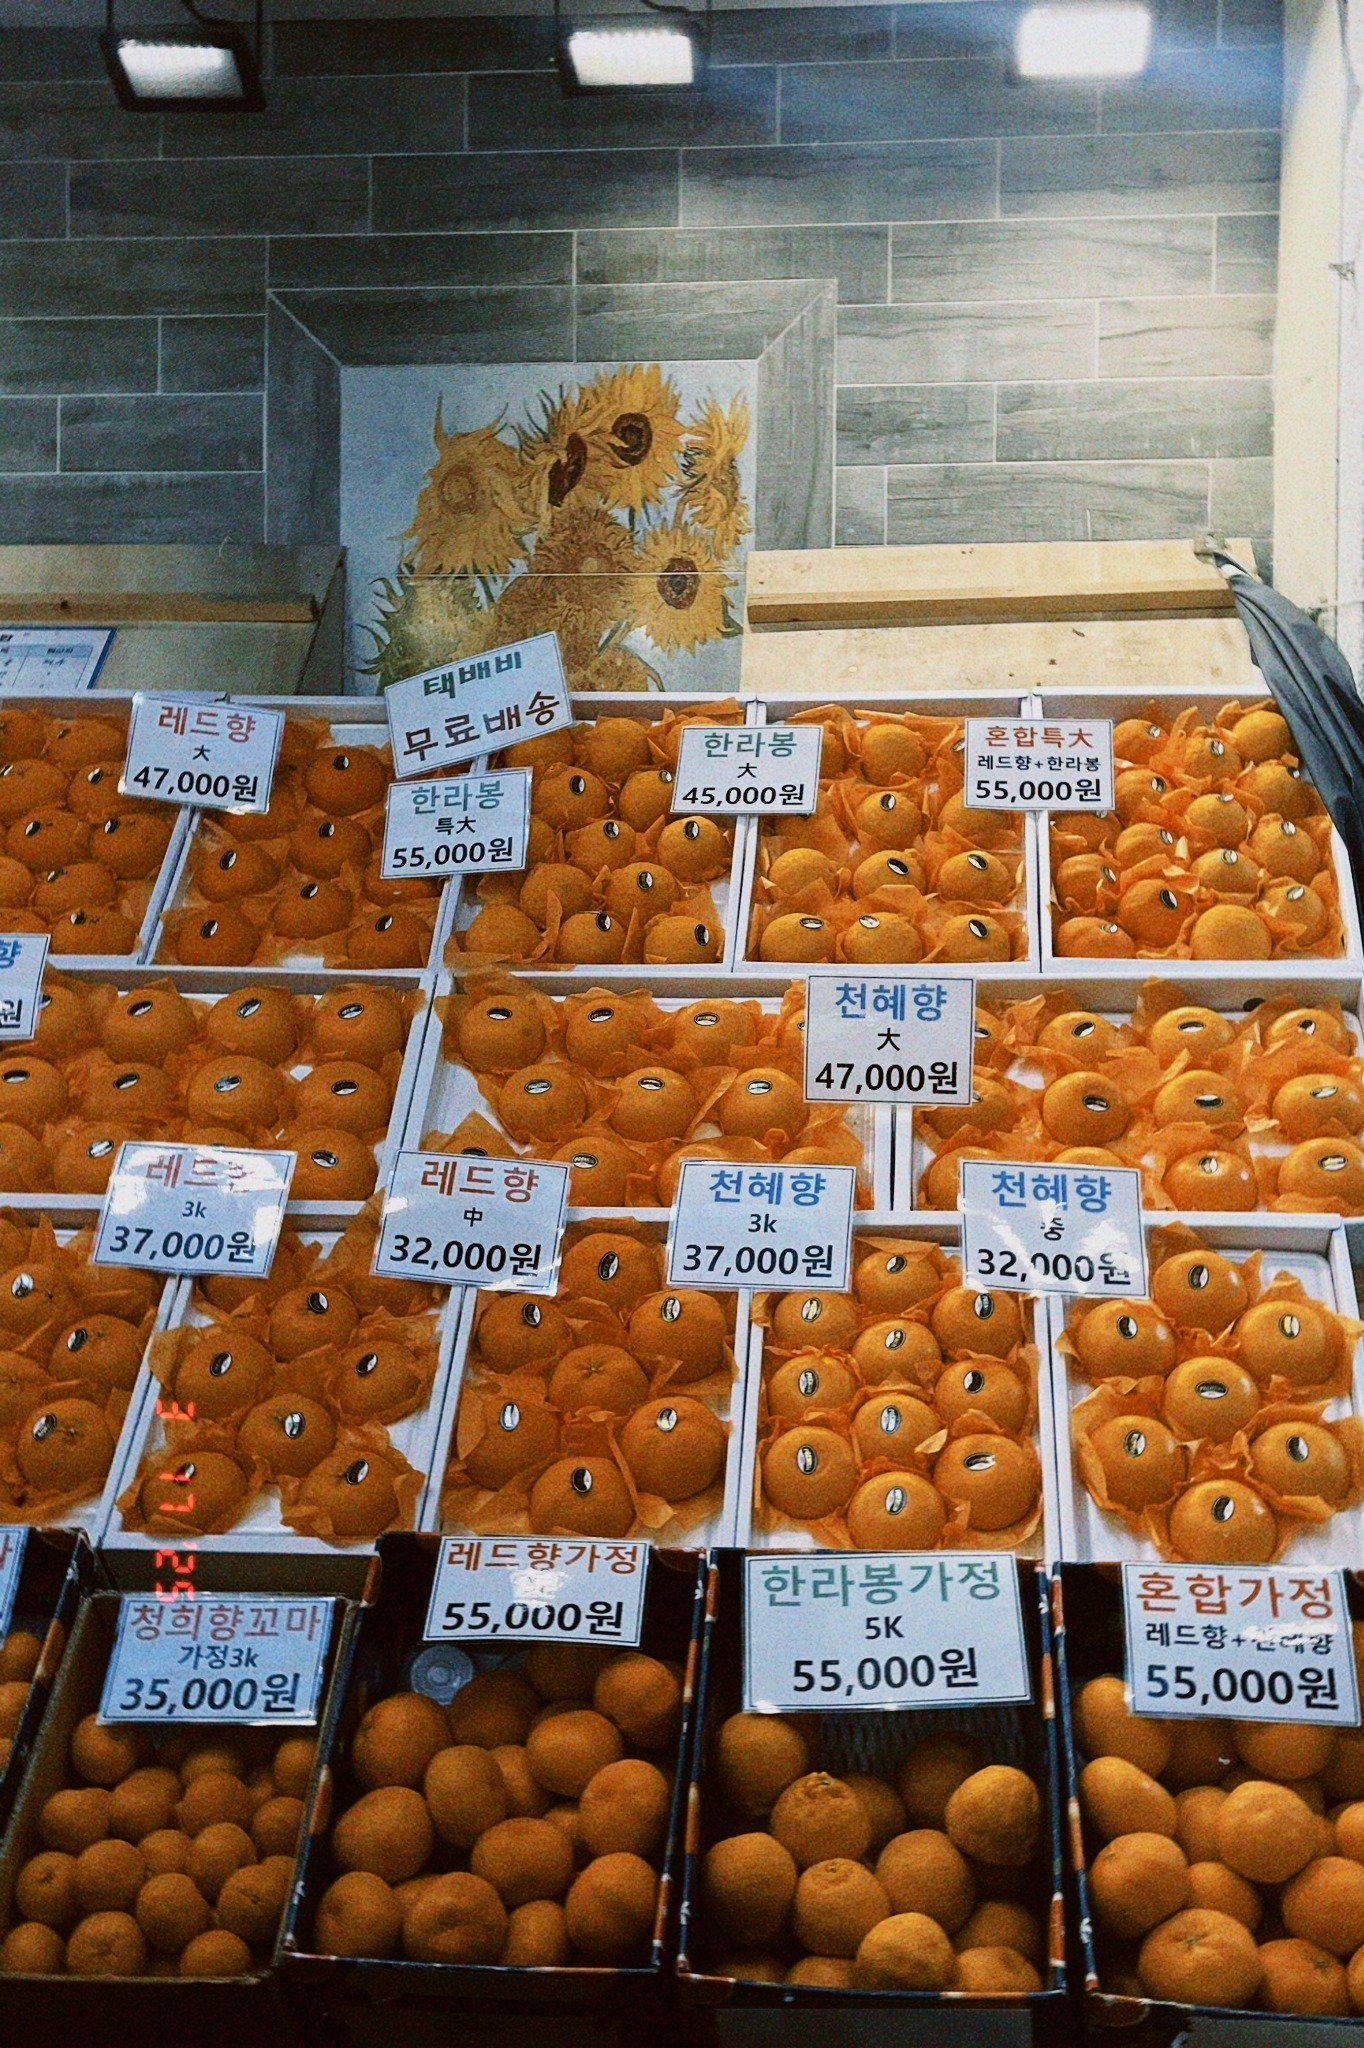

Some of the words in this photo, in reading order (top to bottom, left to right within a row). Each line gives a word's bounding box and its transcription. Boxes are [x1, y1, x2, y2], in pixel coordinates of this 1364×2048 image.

[423, 651, 523, 699] 택배비
[158, 705, 257, 743] 레드향
[403, 690, 561, 762] 무료배송
[985, 725, 1094, 748] 혼합특大
[192, 745, 210, 761] 大
[704, 731, 798, 758] 한라봉
[737, 762, 758, 778] 大
[977, 755, 1102, 772] 레드향+한라봉
[133, 766, 259, 803] 47,000원
[410, 779, 505, 815] 한라봉
[682, 783, 805, 807] 45,000원
[976, 778, 1102, 803] 55,000원
[391, 836, 514, 870] 55,000원
[835, 982, 948, 1022] 천혜향
[876, 1027, 901, 1052] 大
[815, 1061, 958, 1095] 47,000원
[420, 1160, 540, 1203] 레드향
[709, 1169, 827, 1207] 천혜향
[991, 1170, 1112, 1213] 천혜향
[181, 1200, 208, 1219] 3k
[463, 1206, 483, 1227] 中
[747, 1213, 778, 1234] 3k
[109, 1225, 256, 1264] 37,000원
[389, 1233, 542, 1277] 32,000원
[682, 1243, 834, 1279] 37,000원
[446, 1541, 639, 1575] 레드향가정
[760, 1560, 1002, 1608] 한라봉가정
[1135, 1571, 1335, 1620] 혼합가정
[441, 1600, 624, 1638] 55,000원
[864, 1615, 904, 1640] 5K
[792, 1646, 980, 1697] 55,000원
[1146, 1663, 1340, 1711] 55,000원
[119, 1671, 301, 1716] 35,000원
